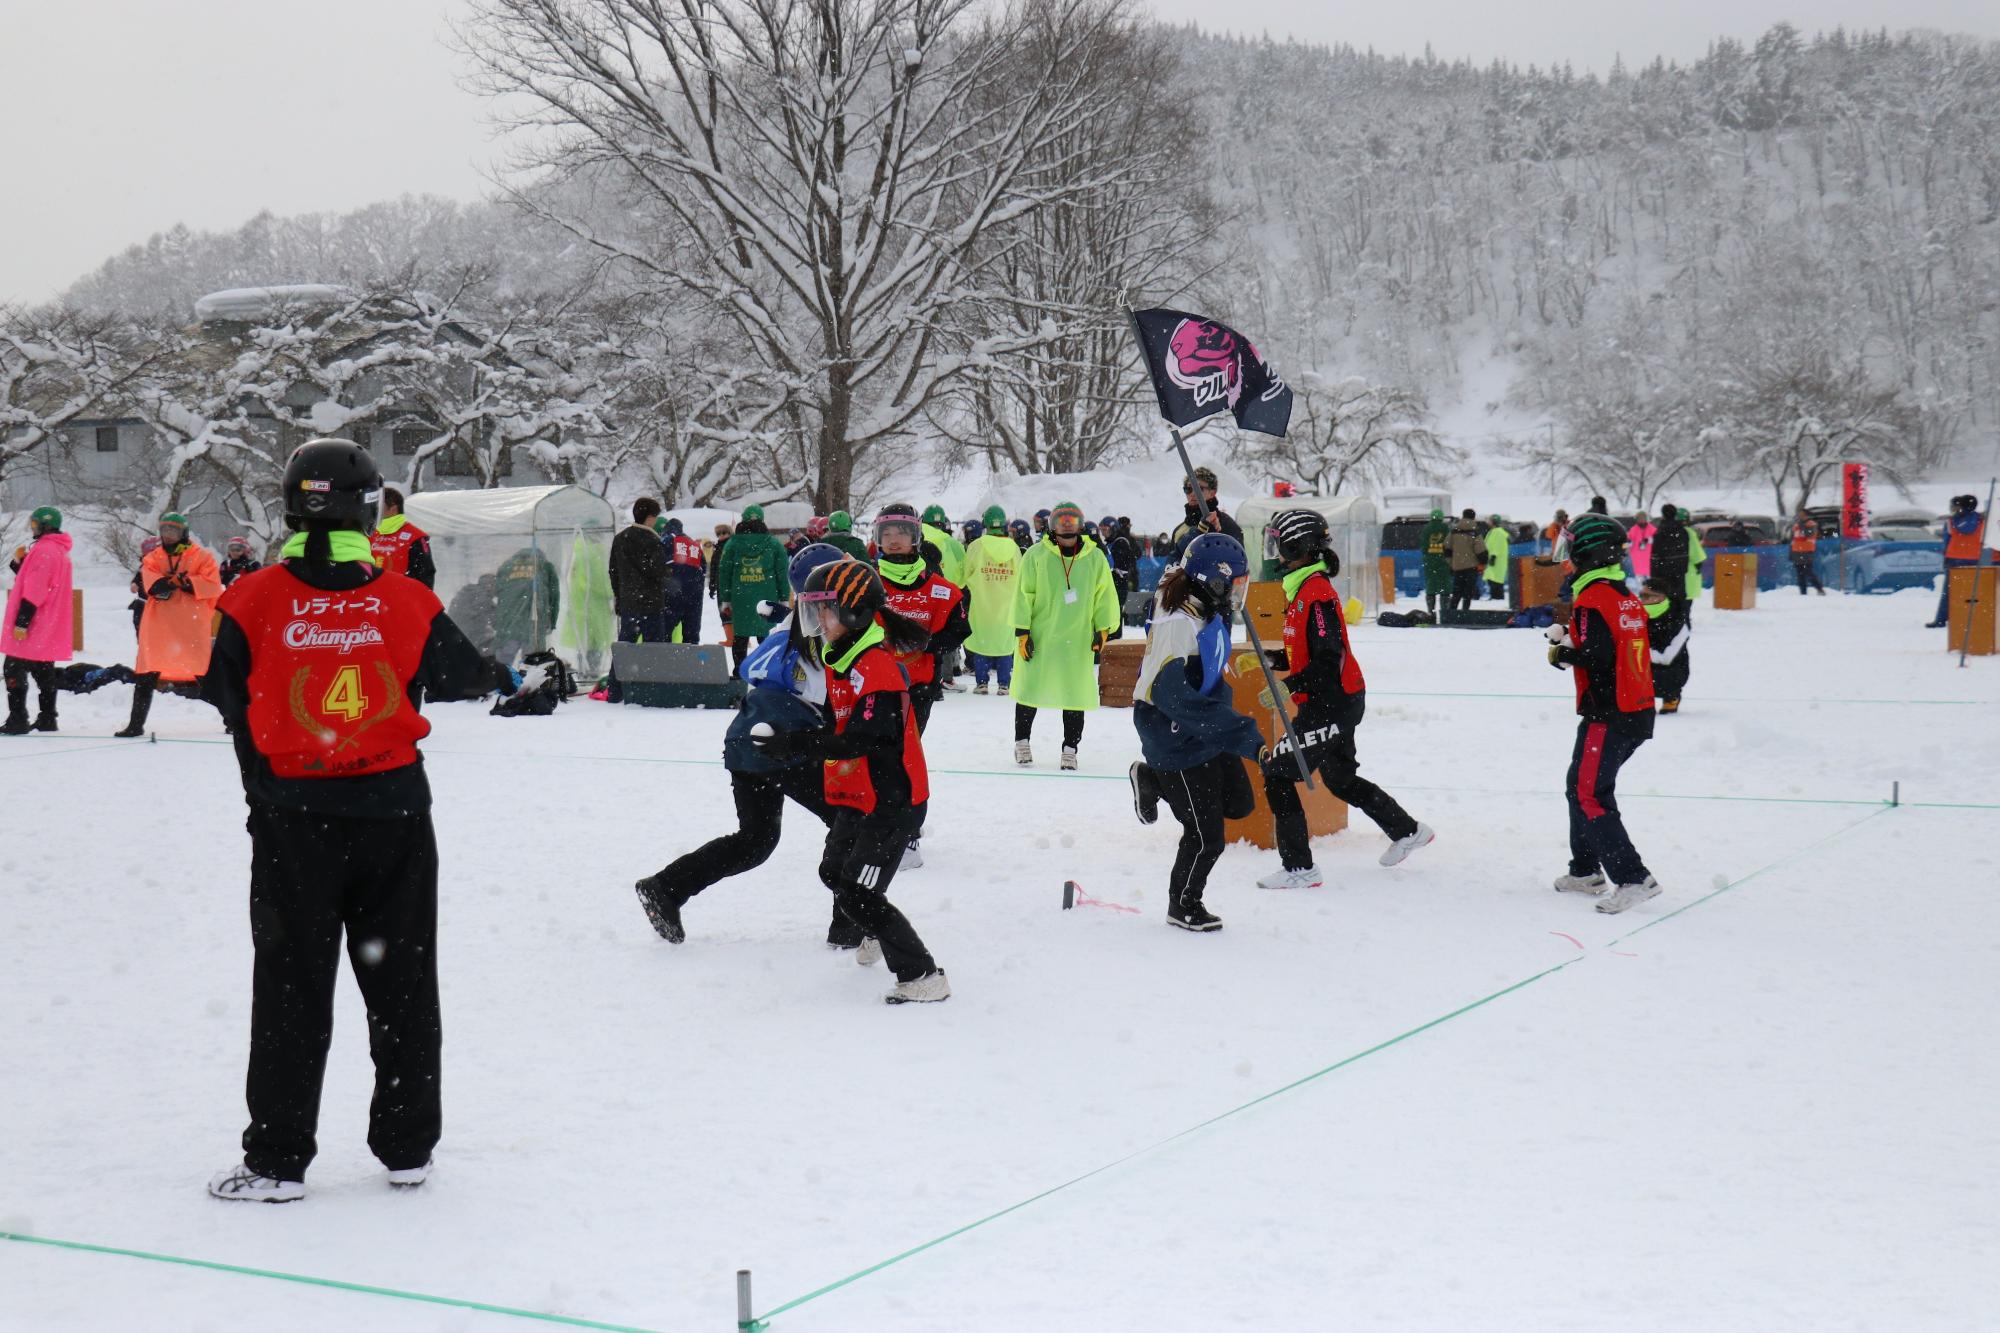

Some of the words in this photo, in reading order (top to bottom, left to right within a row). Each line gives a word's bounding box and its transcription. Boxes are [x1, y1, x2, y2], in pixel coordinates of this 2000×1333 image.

[293, 597, 381, 616] レディース
[886, 593, 927, 604] レディース
[749, 645, 781, 679] 4
[1632, 640, 1644, 672] 7
[323, 665, 368, 722] 4
